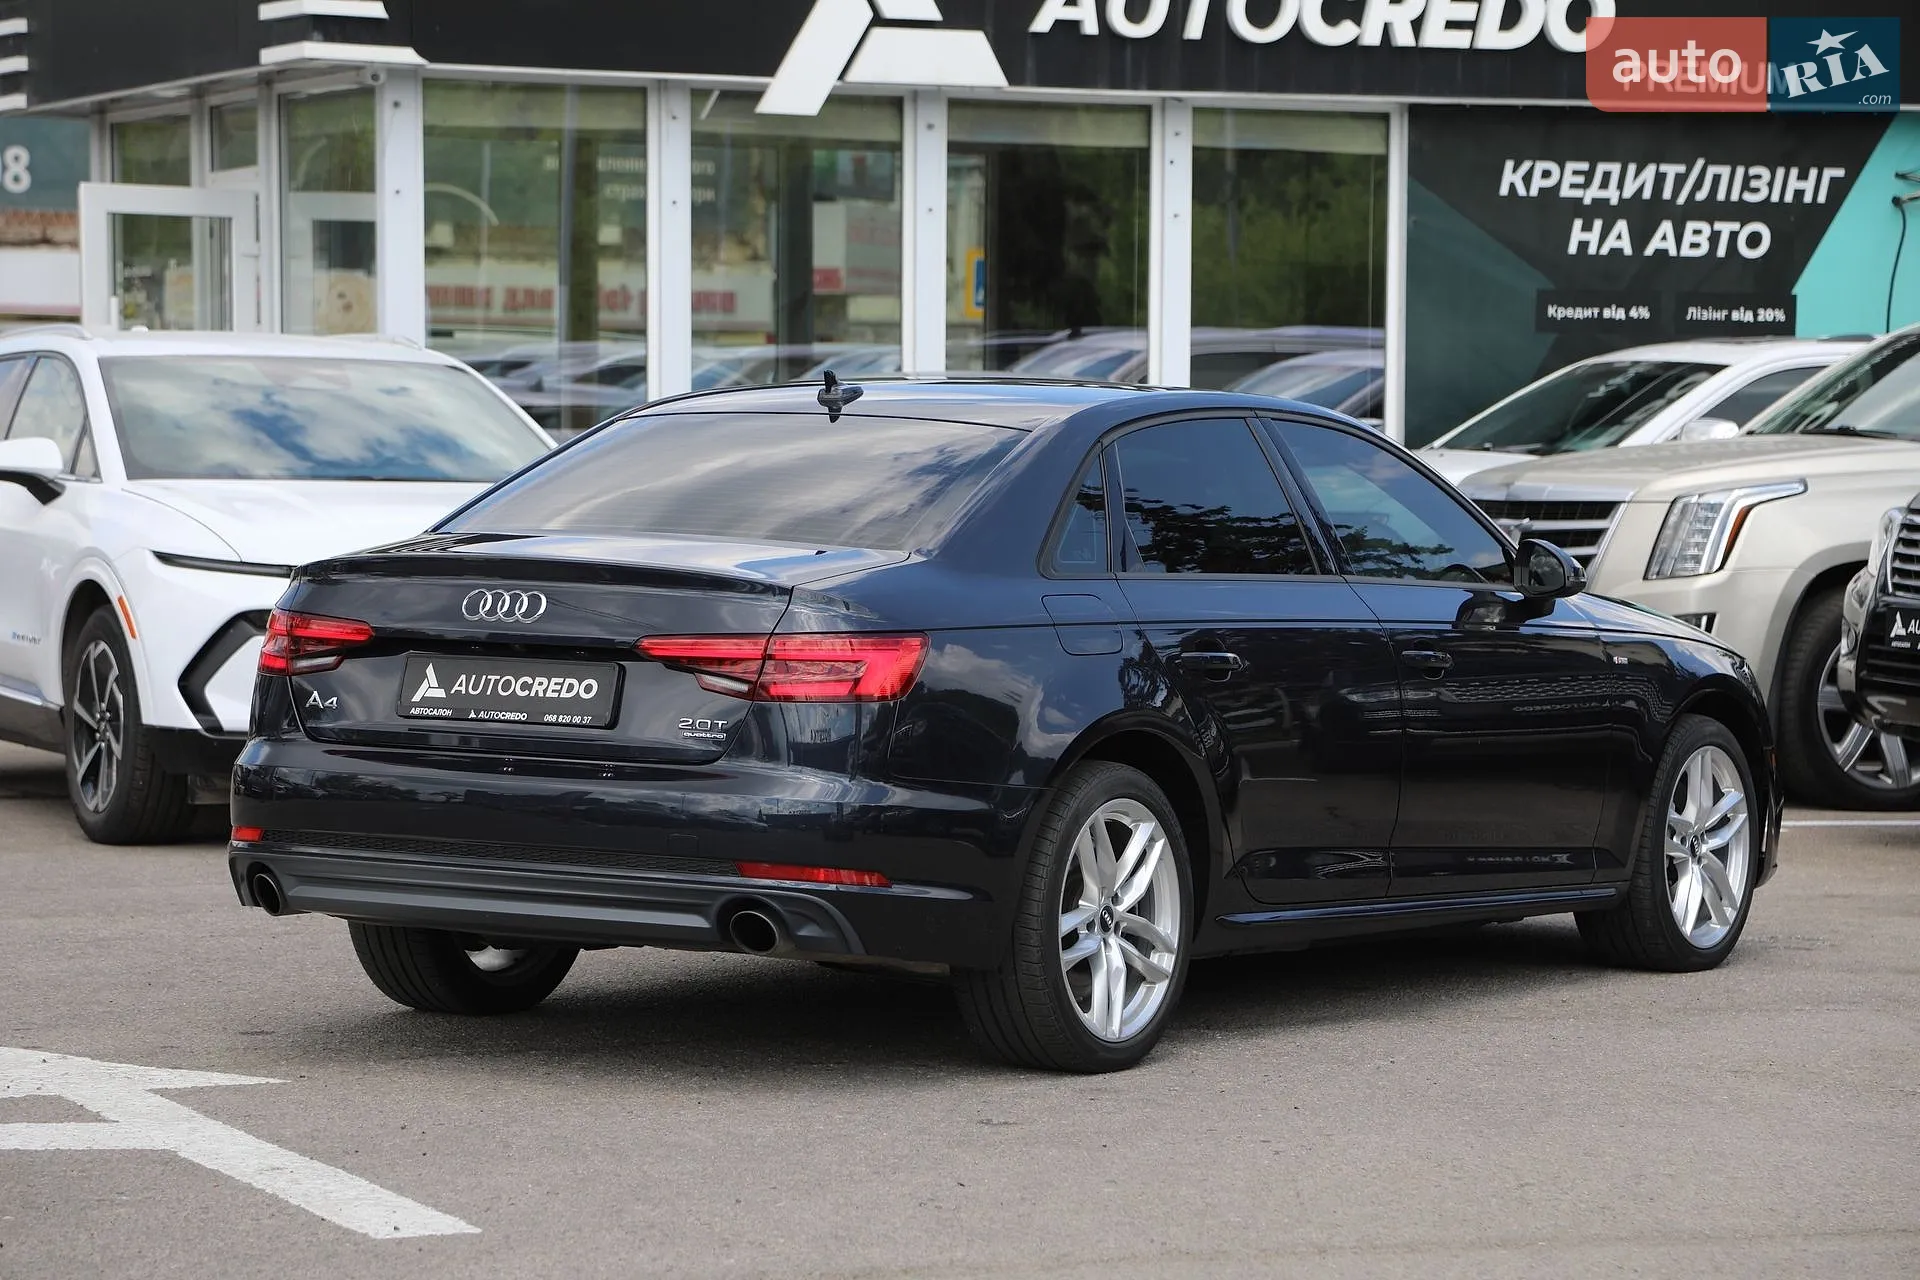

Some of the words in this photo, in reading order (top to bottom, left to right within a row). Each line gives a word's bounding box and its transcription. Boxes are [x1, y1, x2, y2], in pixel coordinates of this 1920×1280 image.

[1499, 158, 1846, 206] КРЕДИТ/ЛІЗІНГ
[1567, 218, 1633, 257] НА
[1644, 219, 1772, 260] АВТО
[1547, 304, 1600, 320] Кредит
[1603, 304, 1626, 320] від
[1629, 305, 1651, 320] 4%
[1686, 306, 1729, 321] Лізінг
[1731, 306, 1754, 322] від
[1757, 307, 1786, 322] 20%
[450, 674, 599, 700] AUTOCREDO
[305, 690, 338, 709] A4
[409, 706, 453, 717] АВТОСАЛОН
[477, 710, 528, 721] AUTOCREDO
[543, 714, 558, 723] 068
[558, 714, 572, 723] 820
[572, 715, 582, 724] 00
[582, 716, 593, 725] 37
[682, 731, 727, 740] quattro
